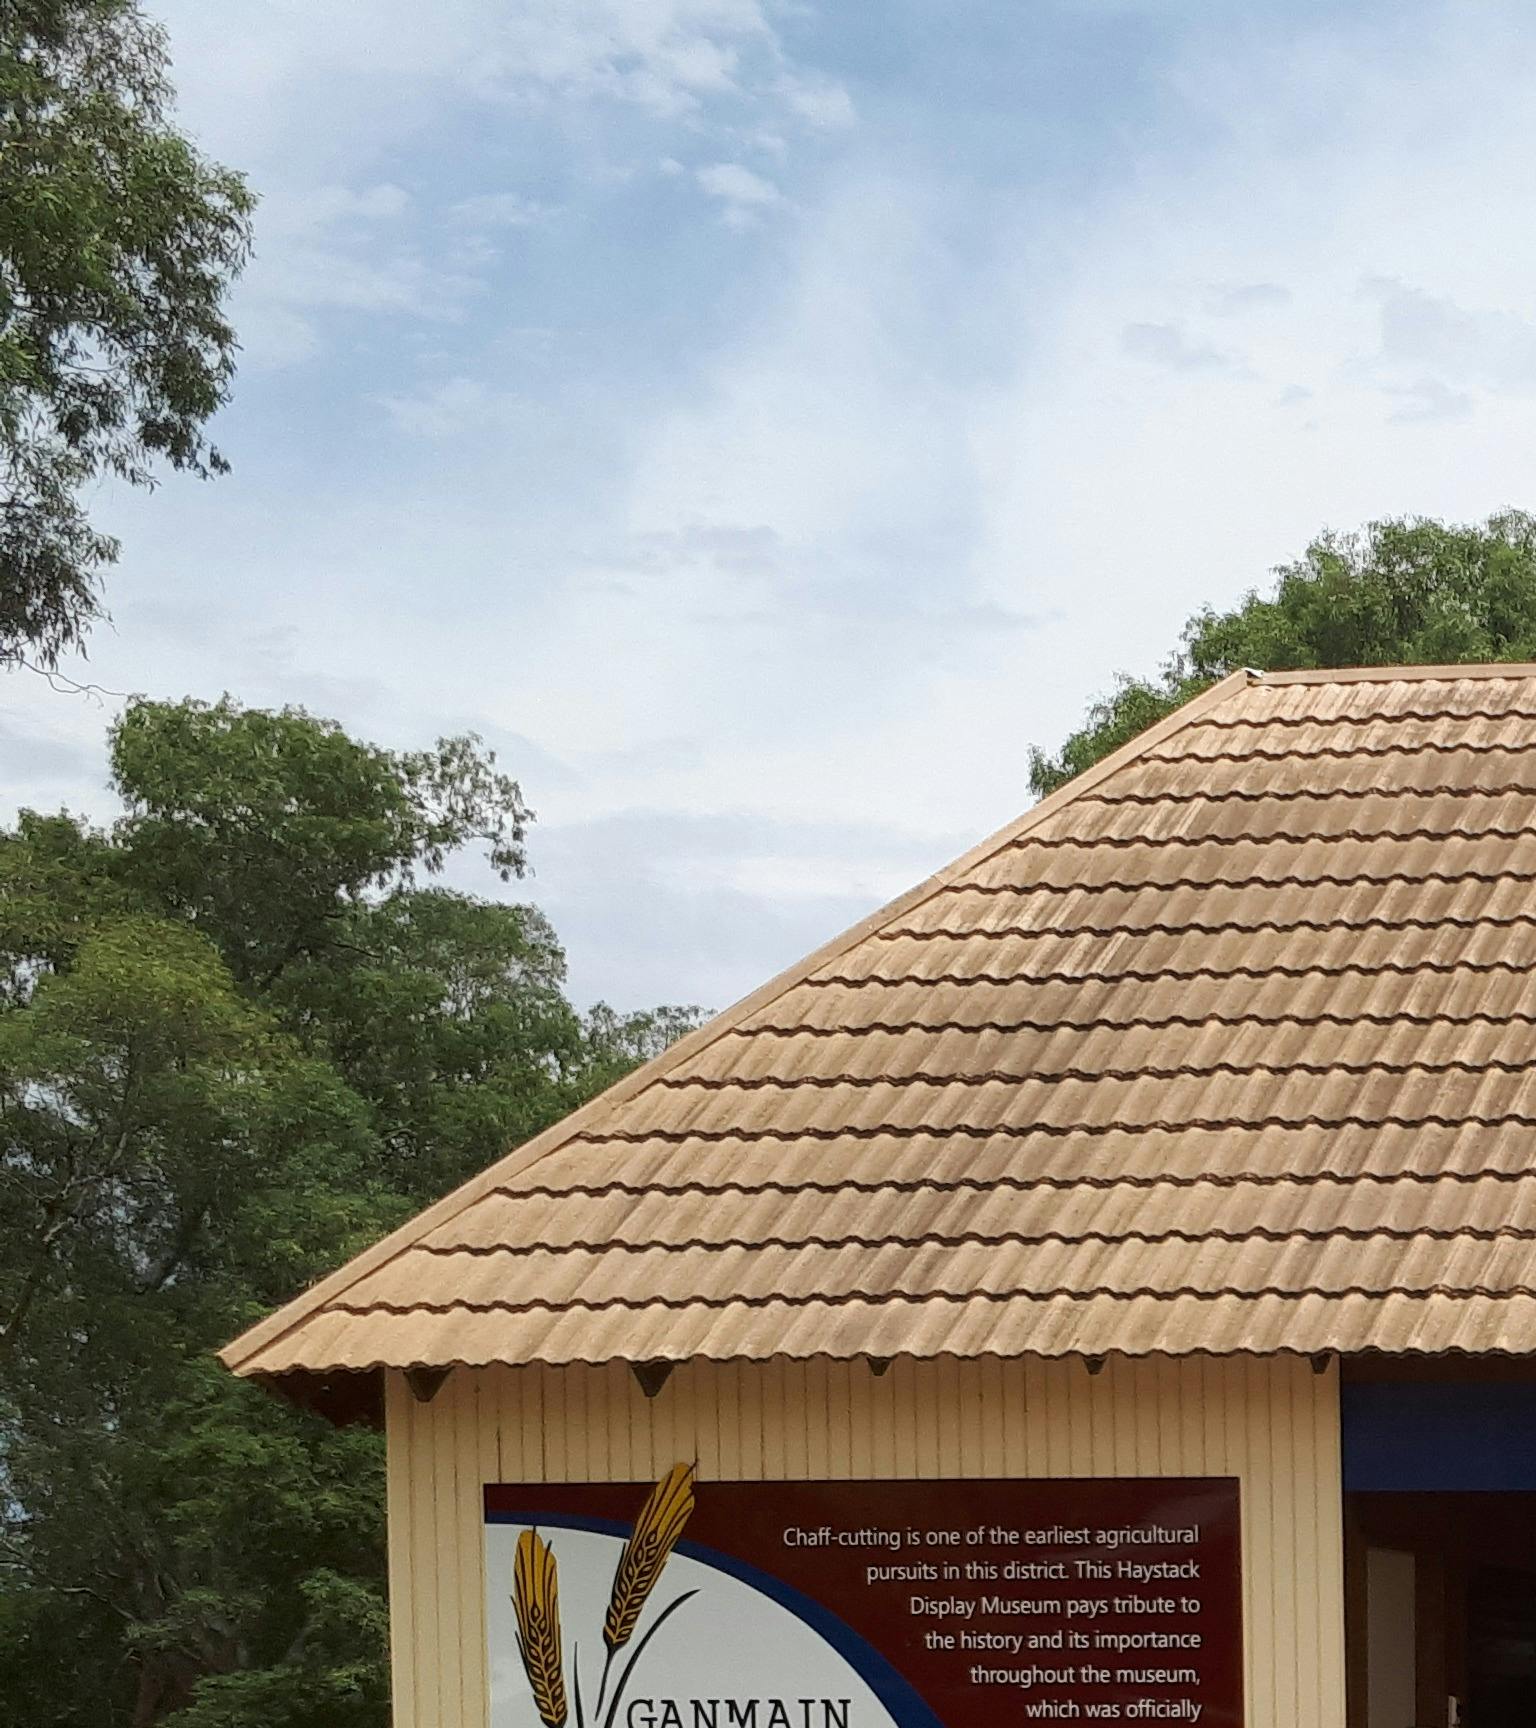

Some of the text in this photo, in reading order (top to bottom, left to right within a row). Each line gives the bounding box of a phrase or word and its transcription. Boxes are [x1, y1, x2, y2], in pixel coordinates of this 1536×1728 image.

[784, 1524, 1198, 1550] Chaff-cutting is one of the earliest agricultural
[867, 1561, 938, 1585] pursuits
[943, 1561, 959, 1579] in
[965, 1561, 998, 1579] this
[1074, 1560, 1111, 1578] This
[1117, 1559, 1200, 1583] Haystack
[911, 1595, 1200, 1619] Display Museum pays tribute to
[925, 1630, 1201, 1654] the history and its importance
[971, 1665, 1200, 1688] throughout the museum,
[1026, 1699, 1202, 1722] which was officially
